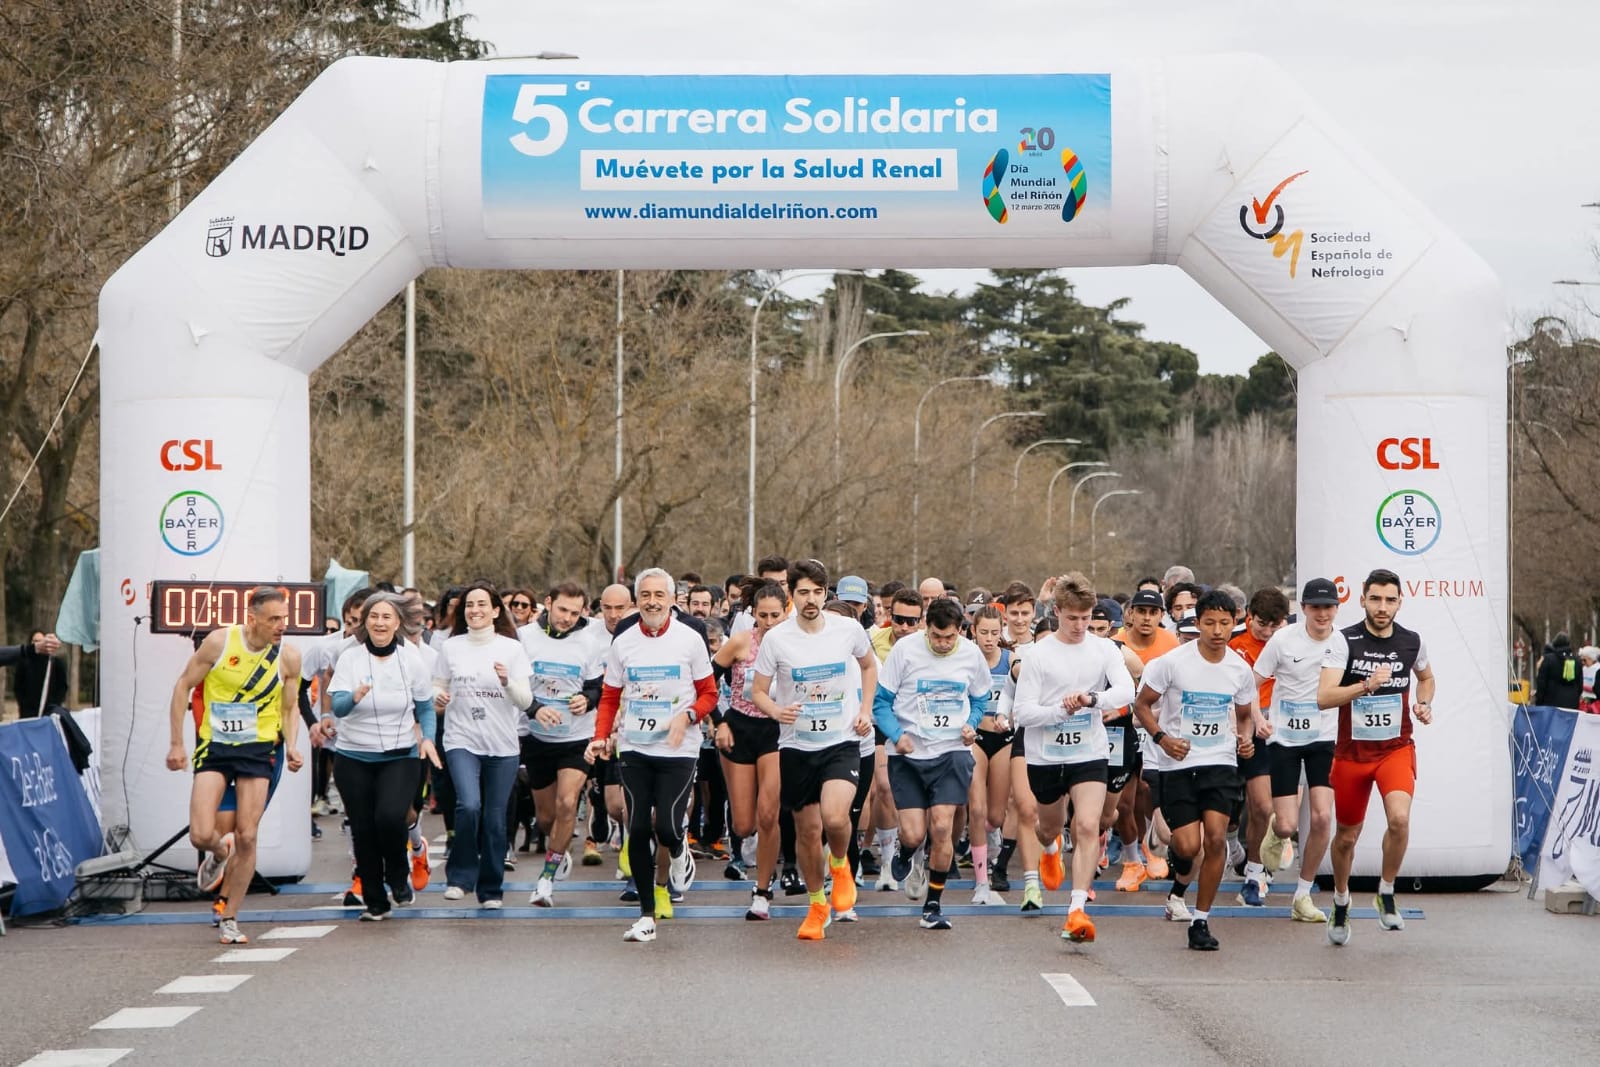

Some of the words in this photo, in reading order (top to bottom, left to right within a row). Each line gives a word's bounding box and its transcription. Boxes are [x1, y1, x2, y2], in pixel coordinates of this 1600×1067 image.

[577, 97, 767, 134] Carrera
[783, 96, 998, 134] Solidaria
[1018, 127, 1055, 153] 20
[595, 158, 704, 179] Muévete
[712, 164, 754, 184] por
[762, 158, 785, 179] la
[793, 158, 864, 178] Salud
[872, 157, 942, 178] Renal
[1010, 164, 1029, 174] Día
[1010, 178, 1056, 187] Mundial
[1010, 191, 1028, 200] del
[1030, 190, 1062, 200] Riñón
[584, 202, 878, 220] www.diamundialdelriñon.com
[1044, 203, 1061, 211] 2026
[241, 225, 369, 257] MADRID
[1311, 232, 1371, 244] Sociedad
[1311, 249, 1372, 263] Española
[1377, 249, 1393, 260] de
[160, 439, 222, 471] CSL
[1376, 438, 1440, 470] CSL
[165, 518, 218, 529] BAYER
[186, 497, 197, 551] BAYER
[1382, 517, 1436, 528] BAYER
[1404, 495, 1415, 550] BAYER
[475, 691, 505, 699] RENAL
[222, 720, 244, 732] 311
[638, 718, 657, 731] 79
[810, 719, 828, 732] 13
[933, 715, 949, 728] 32
[1287, 718, 1311, 730] 418
[1364, 713, 1392, 727] 315
[1191, 723, 1219, 736] 378
[1055, 732, 1082, 745] 415
